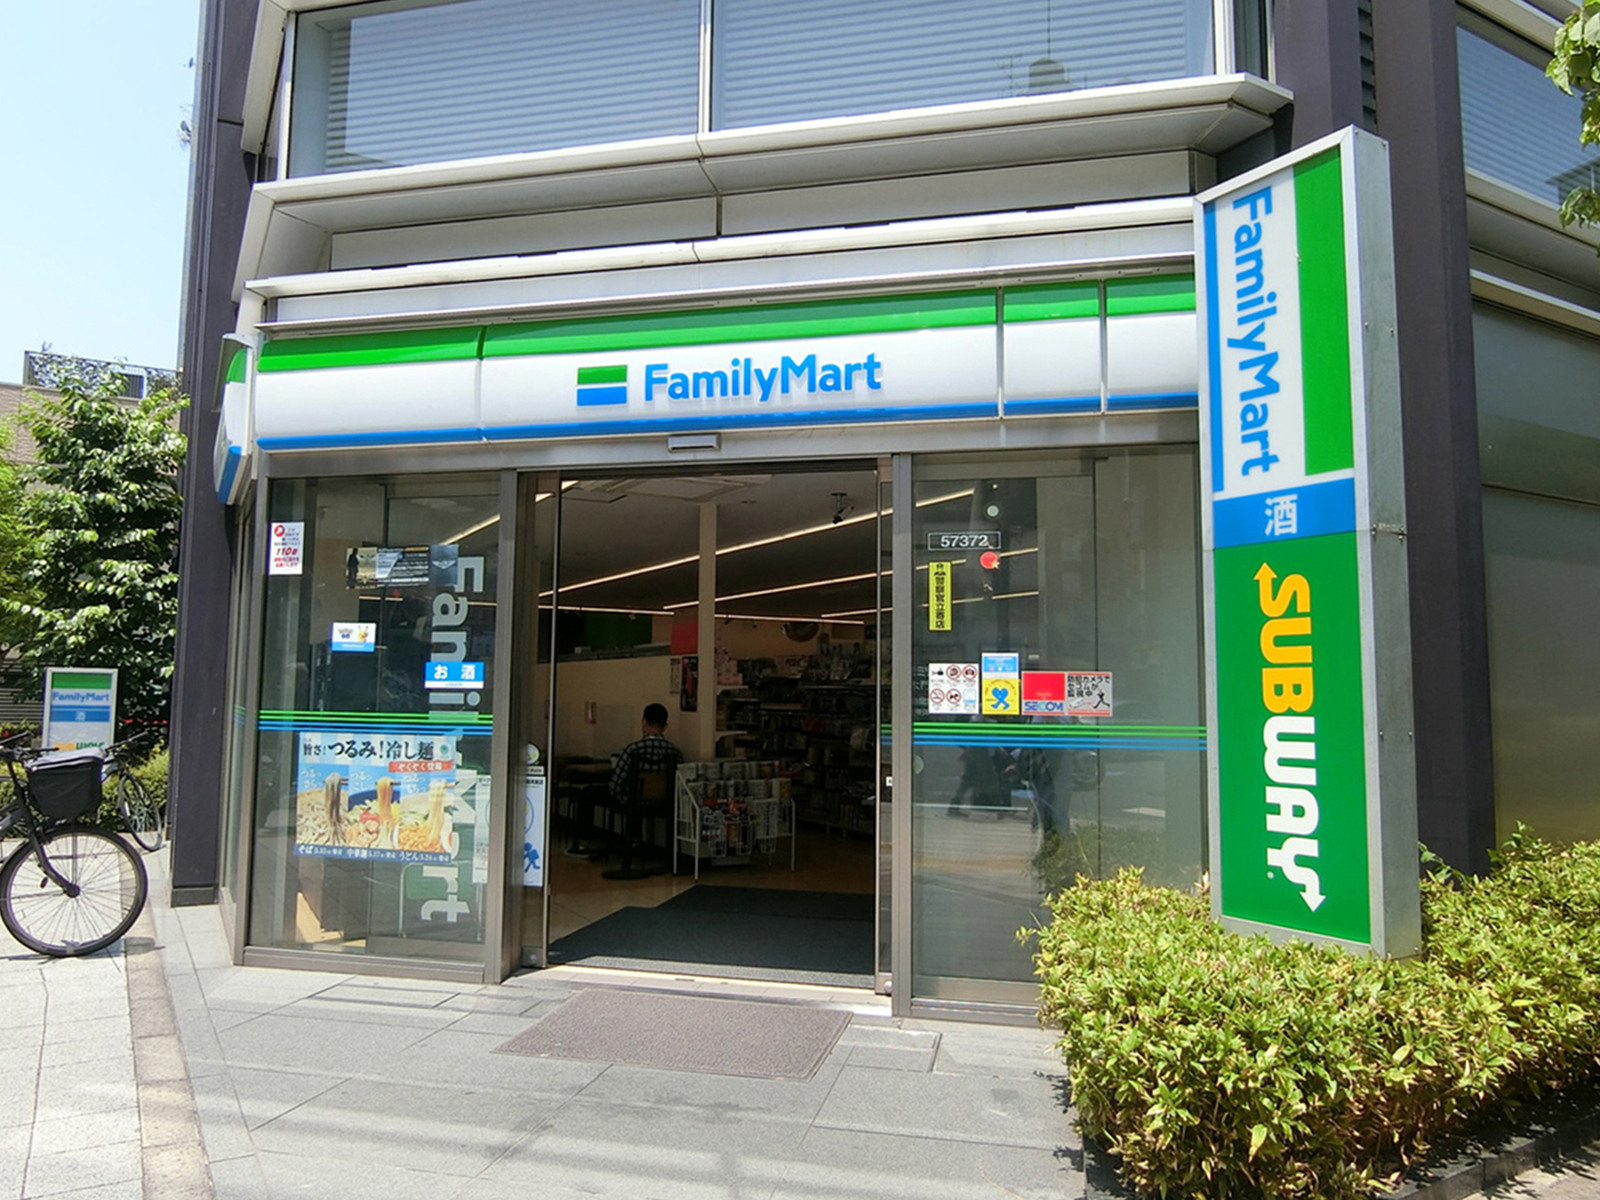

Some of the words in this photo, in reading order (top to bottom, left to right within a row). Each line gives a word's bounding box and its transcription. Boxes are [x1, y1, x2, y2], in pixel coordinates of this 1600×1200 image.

[1227, 185, 1280, 476] FamilyMart
[644, 352, 881, 402] FamilyMart
[1264, 493, 1298, 536] 酒
[941, 535, 988, 547] 57372
[434, 664, 475, 680] お酒
[52, 691, 109, 703] FamilyMart
[1024, 701, 1064, 711] SECOM
[1253, 562, 1326, 912] SUBWAY
